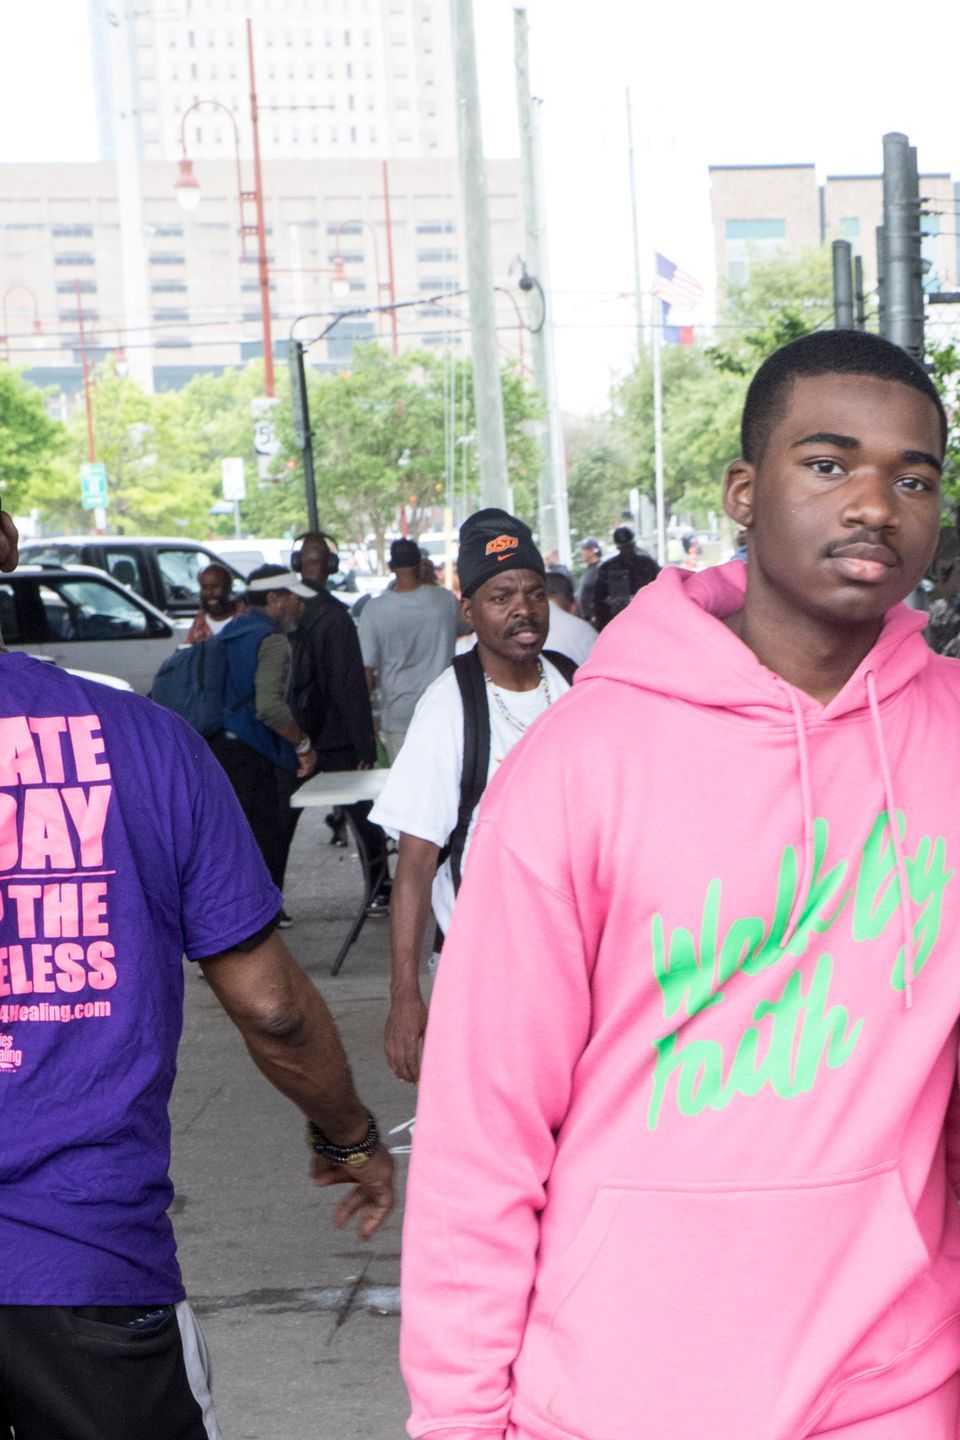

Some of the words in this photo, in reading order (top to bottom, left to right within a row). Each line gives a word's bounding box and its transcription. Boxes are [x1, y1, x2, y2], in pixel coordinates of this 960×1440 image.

[8, 882, 109, 938] THE
[651, 817, 853, 1019] Walk
[853, 808, 955, 991] By
[648, 953, 864, 1131] Faith
